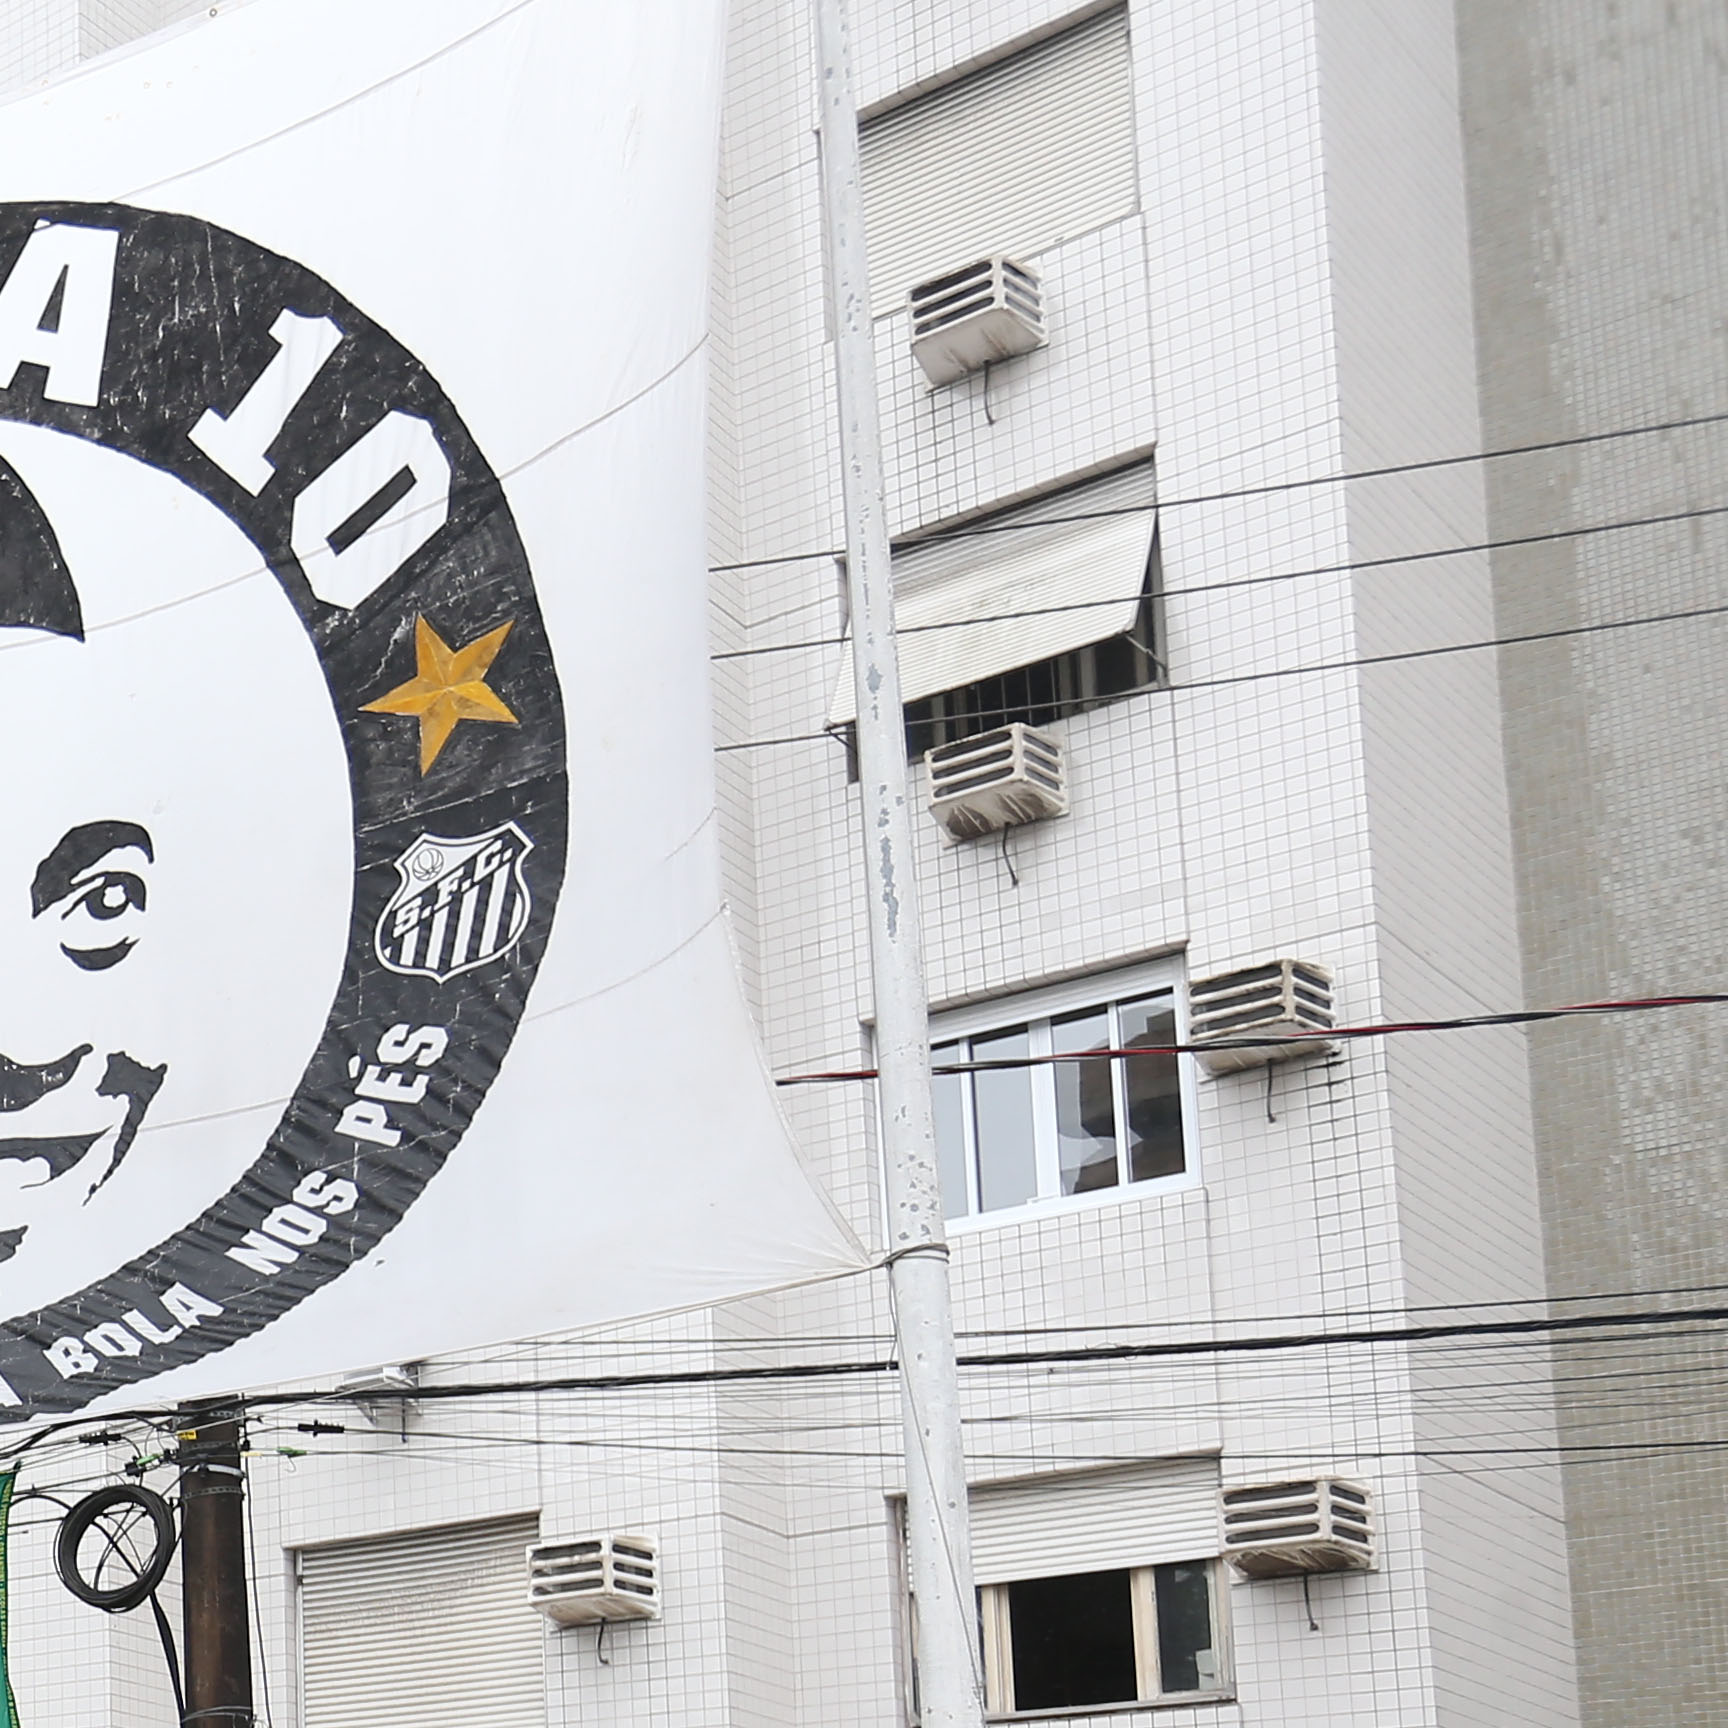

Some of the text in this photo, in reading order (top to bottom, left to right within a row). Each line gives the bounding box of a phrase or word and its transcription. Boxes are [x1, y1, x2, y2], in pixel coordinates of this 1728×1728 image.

[187, 306, 453, 612] 10
[393, 839, 513, 938] S.F.C.
[43, 1281, 225, 1379] BOLA
[225, 1170, 360, 1276] NOS
[334, 1022, 449, 1147] PÉS
